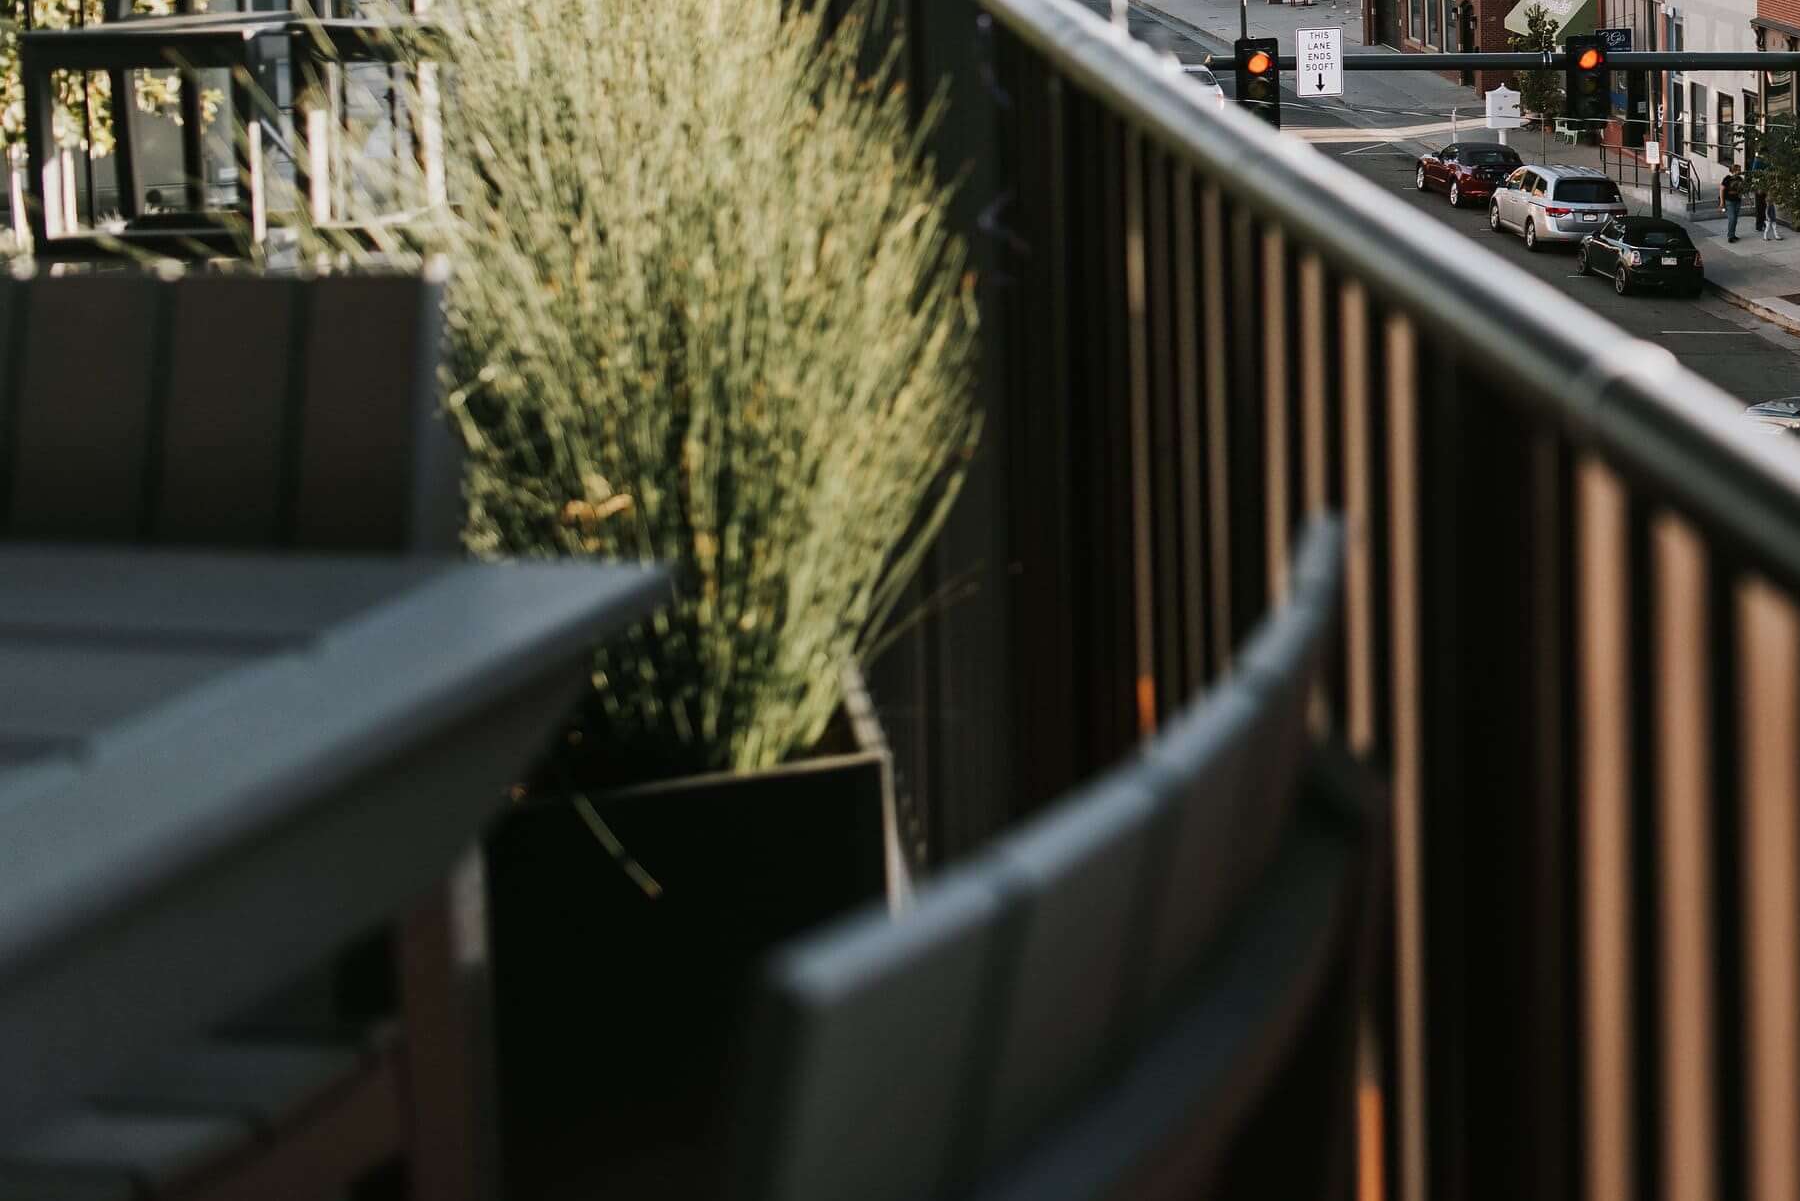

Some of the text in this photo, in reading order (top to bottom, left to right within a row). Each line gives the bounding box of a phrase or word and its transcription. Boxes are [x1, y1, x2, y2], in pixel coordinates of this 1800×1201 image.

[1310, 31, 1329, 39] THIS
[1307, 41, 1332, 50] LANE
[1307, 52, 1332, 61] ENDS
